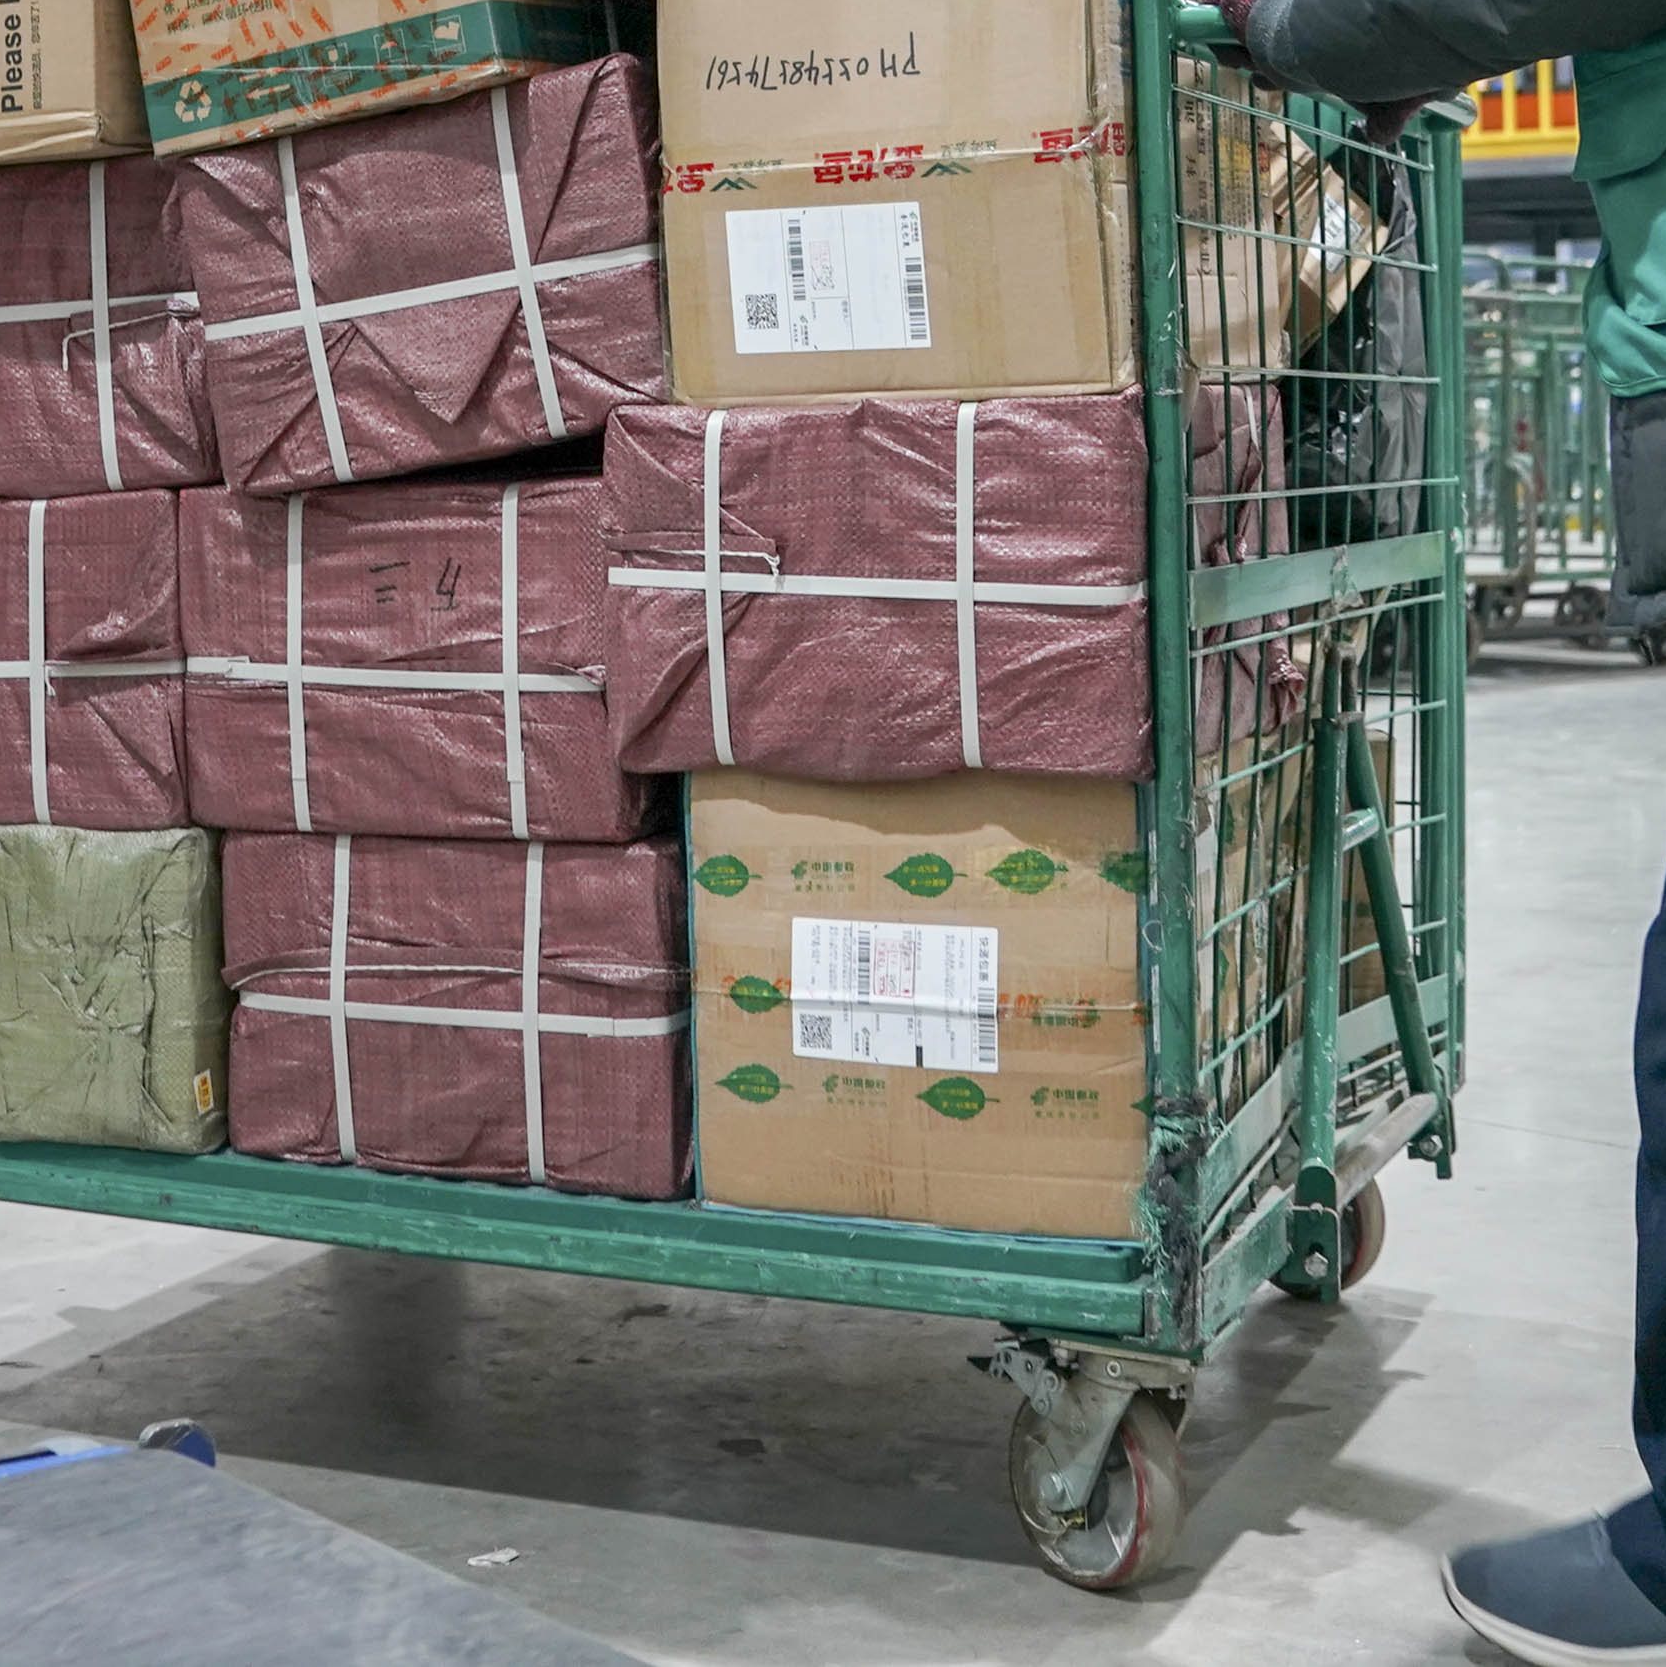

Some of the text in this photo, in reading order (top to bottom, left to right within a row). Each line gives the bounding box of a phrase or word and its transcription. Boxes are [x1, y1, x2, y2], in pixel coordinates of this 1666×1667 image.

[0, 13, 24, 115] Please
[880, 31, 921, 79] PH
[814, 144, 924, 185] 金龙鱼
